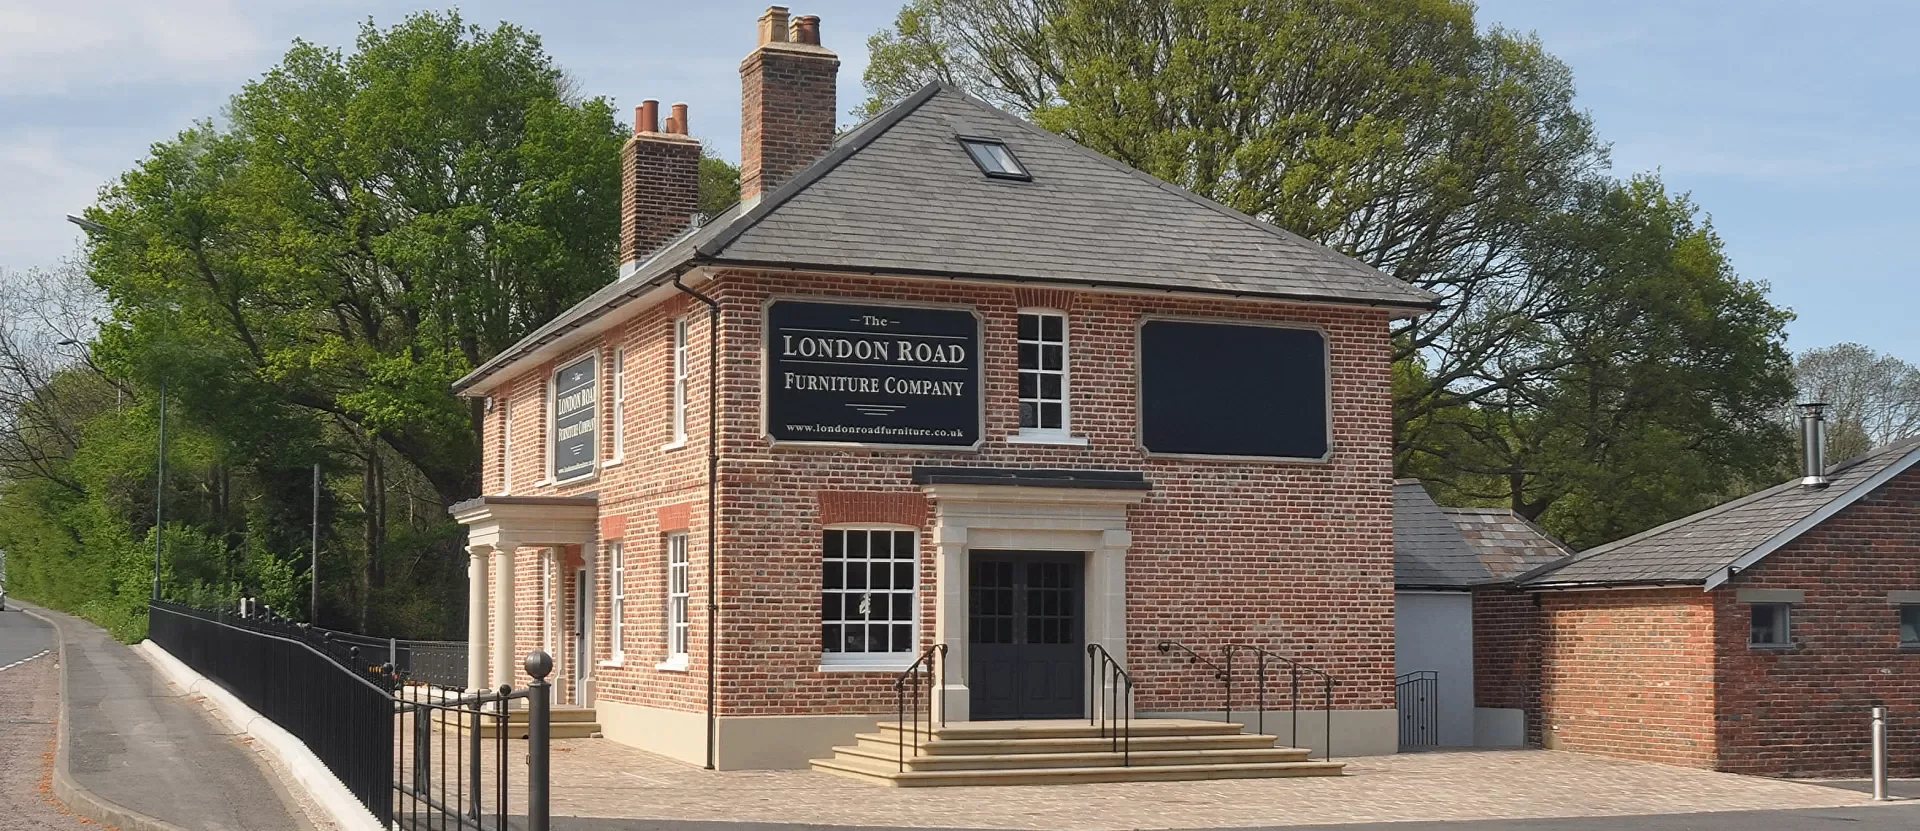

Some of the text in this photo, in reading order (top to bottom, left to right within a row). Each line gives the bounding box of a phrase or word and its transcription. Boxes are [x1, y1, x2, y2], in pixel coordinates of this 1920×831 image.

[862, 315, 888, 326] The
[783, 335, 966, 364] LONDON ROAD
[784, 372, 964, 396] FURNITURE COMPANY
[558, 392, 581, 415] LONDON
[786, 423, 963, 437] www.londonroadfurniture.co.uk
